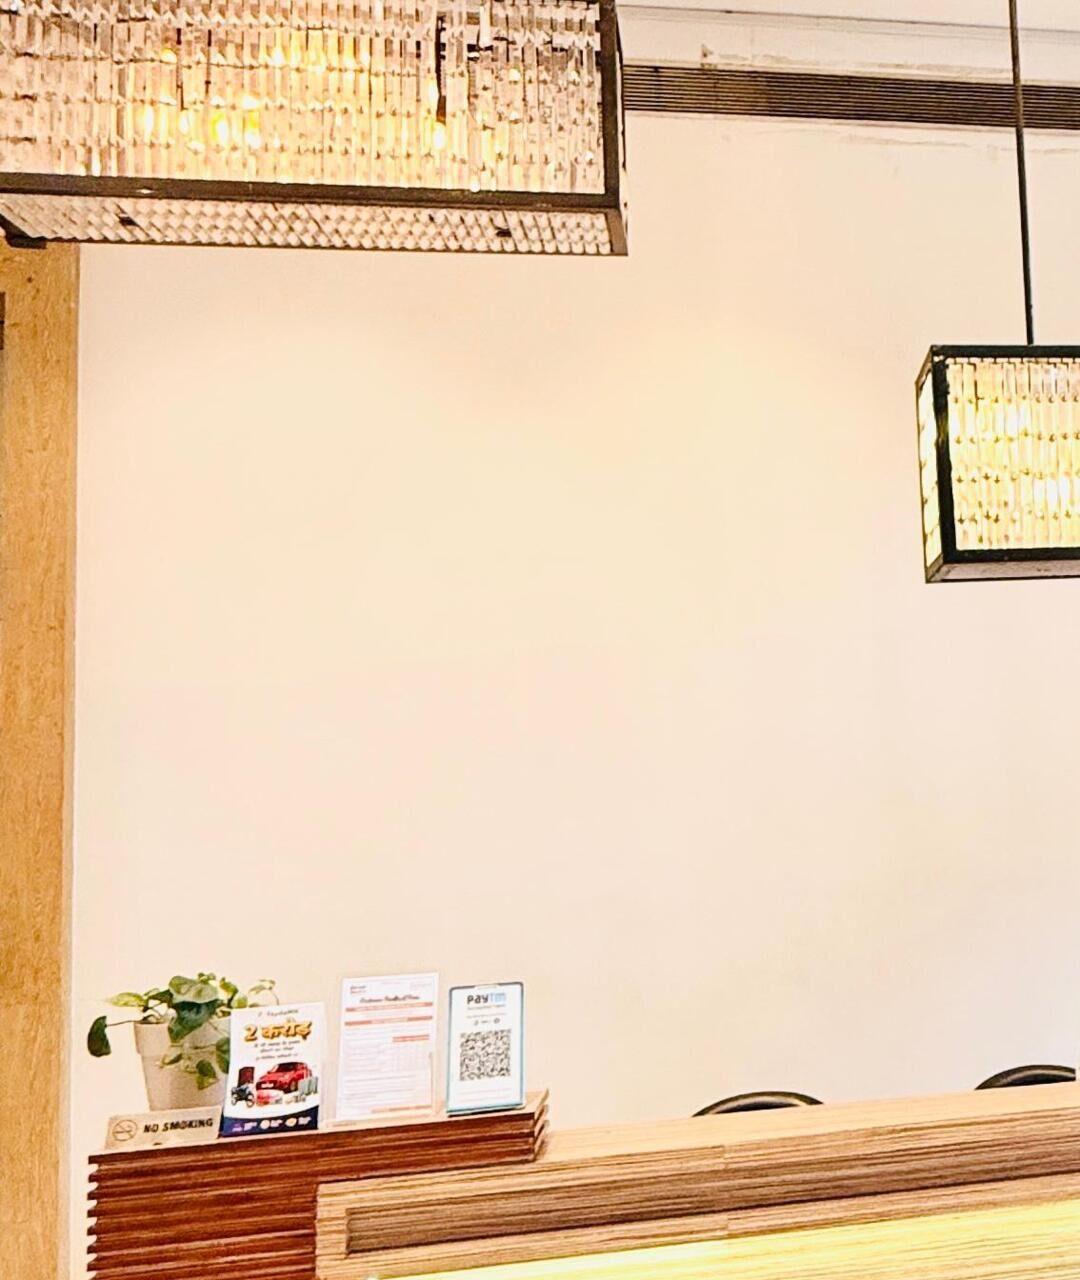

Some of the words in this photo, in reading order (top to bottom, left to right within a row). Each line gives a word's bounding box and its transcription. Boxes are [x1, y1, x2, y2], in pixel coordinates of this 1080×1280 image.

[244, 1023, 258, 1042] 2
[143, 1123, 160, 1134] NO
[161, 1117, 214, 1133] SMOKING
